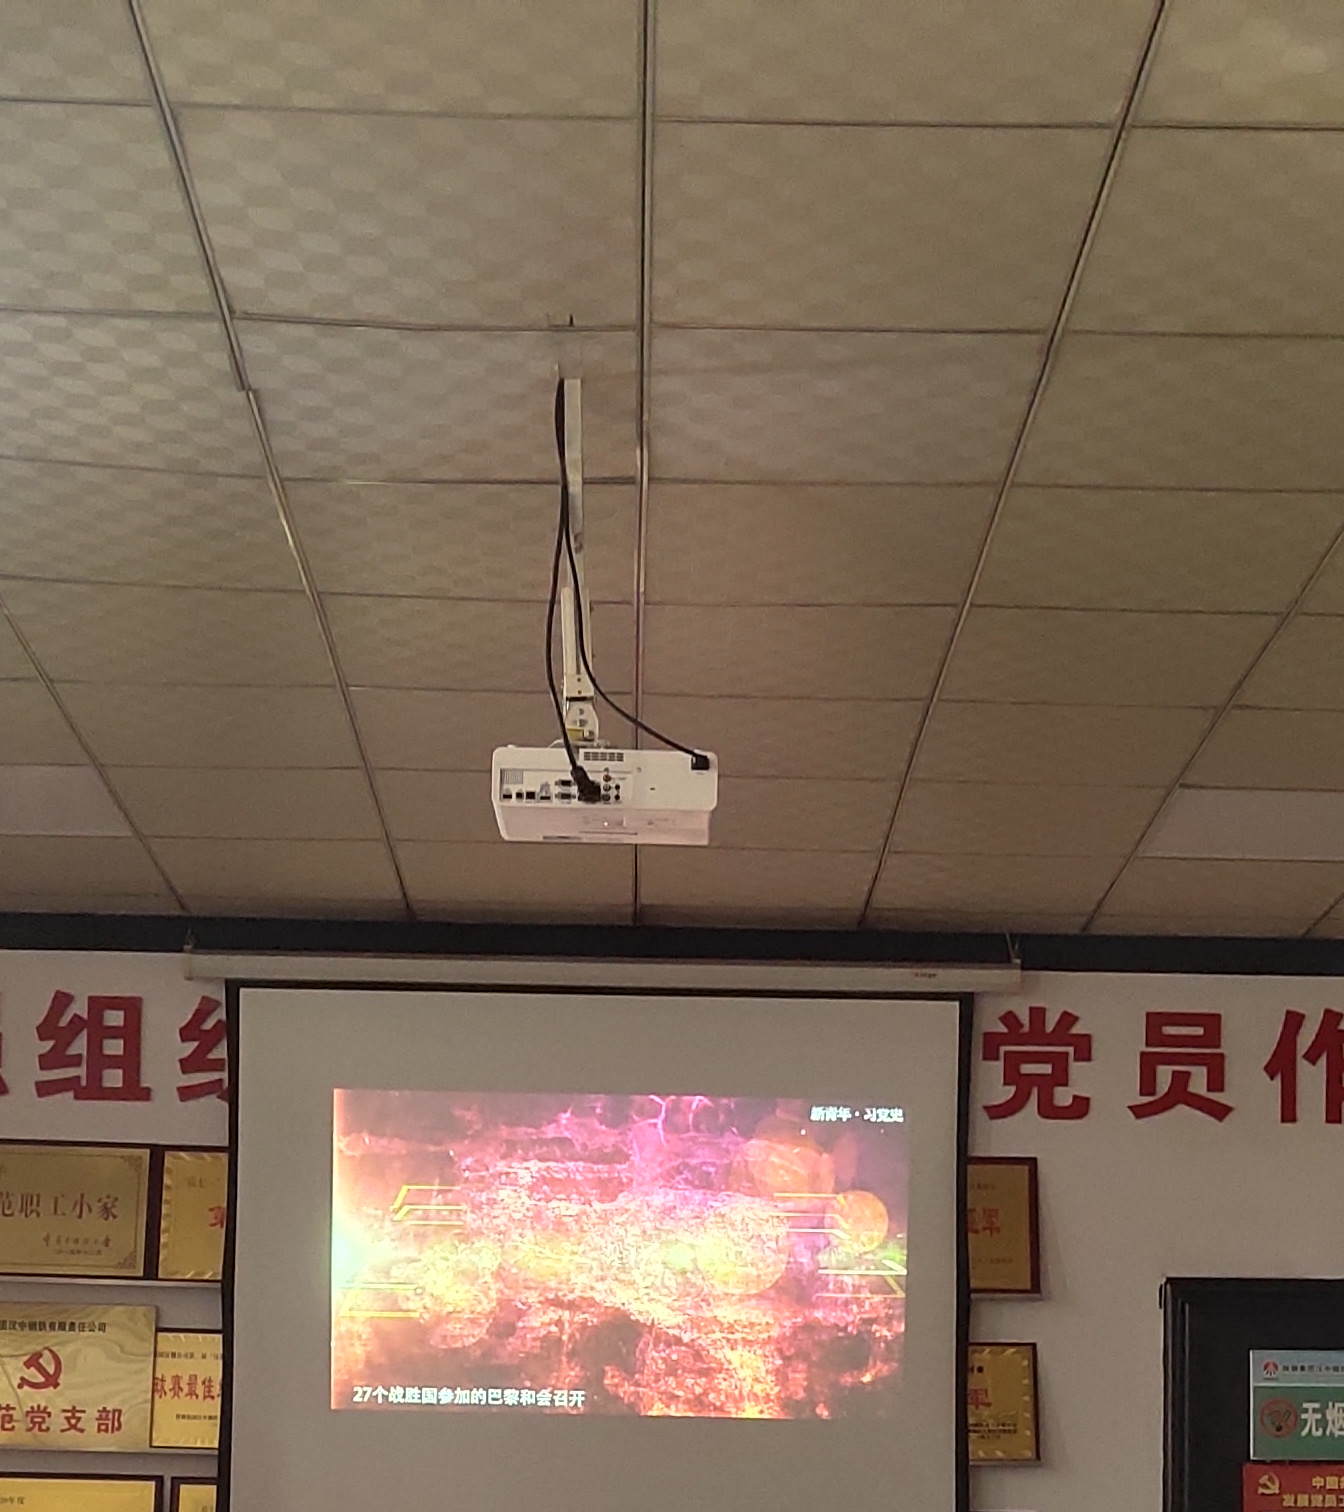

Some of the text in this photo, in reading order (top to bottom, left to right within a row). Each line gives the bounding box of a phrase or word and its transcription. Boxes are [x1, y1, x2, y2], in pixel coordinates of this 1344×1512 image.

[352, 1386, 585, 1407] 27个战胜国参加的巴黎和会召开
